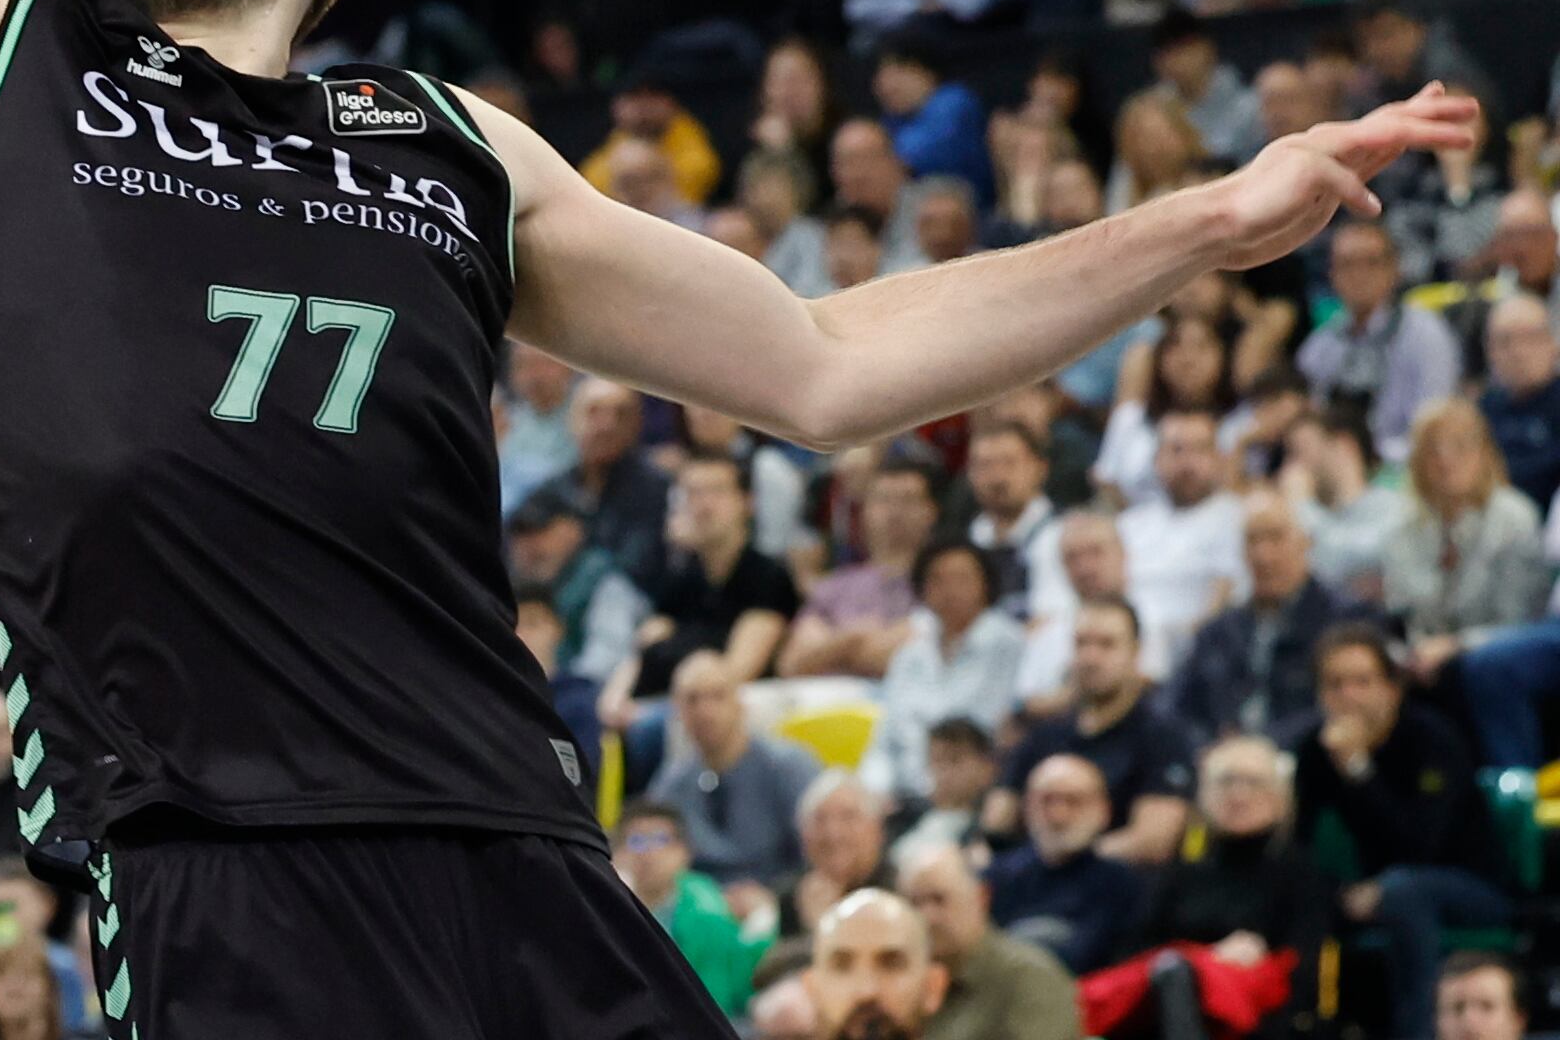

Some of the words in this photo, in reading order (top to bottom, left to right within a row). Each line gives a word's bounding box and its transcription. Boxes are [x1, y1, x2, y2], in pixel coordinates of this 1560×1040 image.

[126, 57, 183, 88] hummel
[336, 91, 374, 110] liga
[339, 106, 418, 125] endesa
[72, 162, 242, 211] seguros
[258, 197, 285, 217] &
[207, 284, 396, 434] 77
